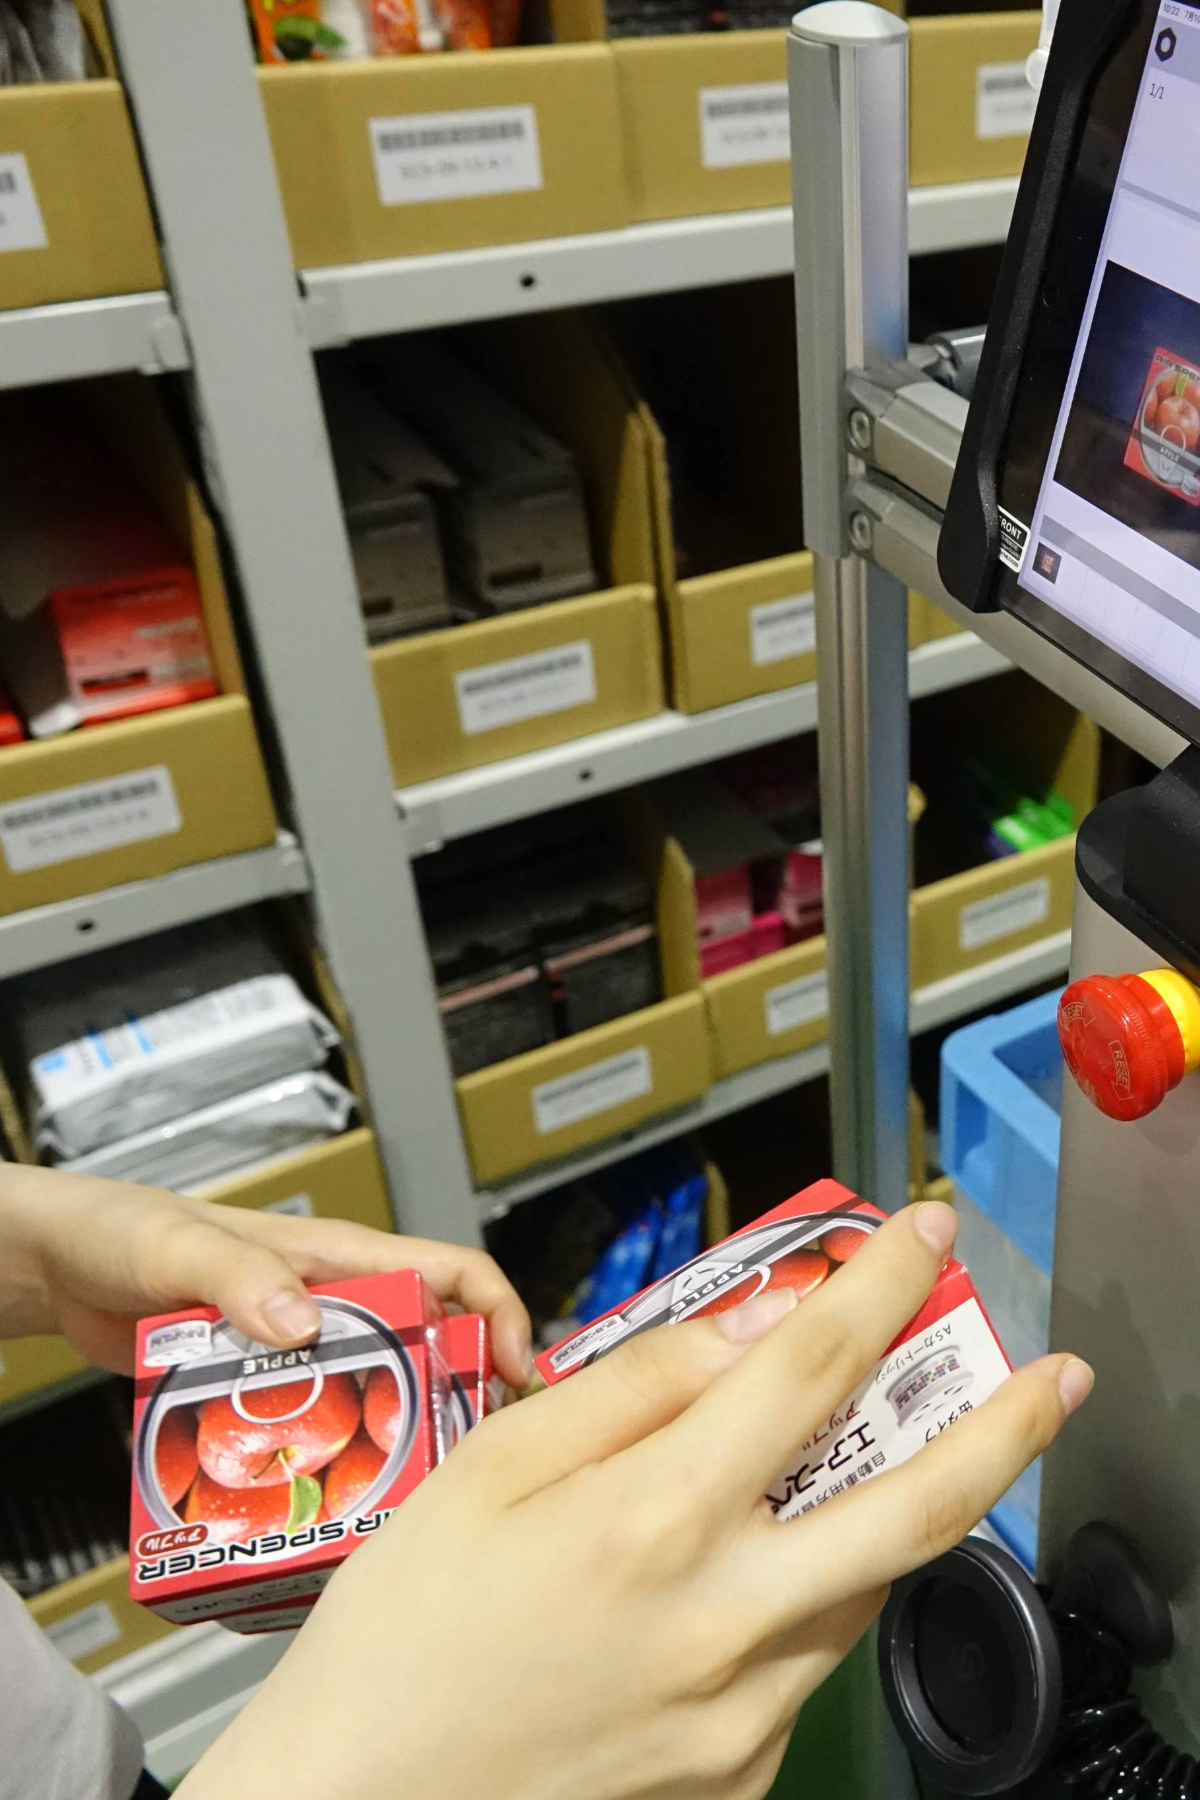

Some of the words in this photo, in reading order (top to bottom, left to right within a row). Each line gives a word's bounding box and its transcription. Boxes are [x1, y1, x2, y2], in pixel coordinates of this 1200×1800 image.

[1163, 4, 1180, 16] 10:22
[1150, 83, 1164, 100] 1/1
[999, 515, 1022, 540] RONT
[670, 1263, 744, 1314] APPLE
[243, 1349, 311, 1374] APPLE
[138, 1521, 344, 1582] SPENCER
